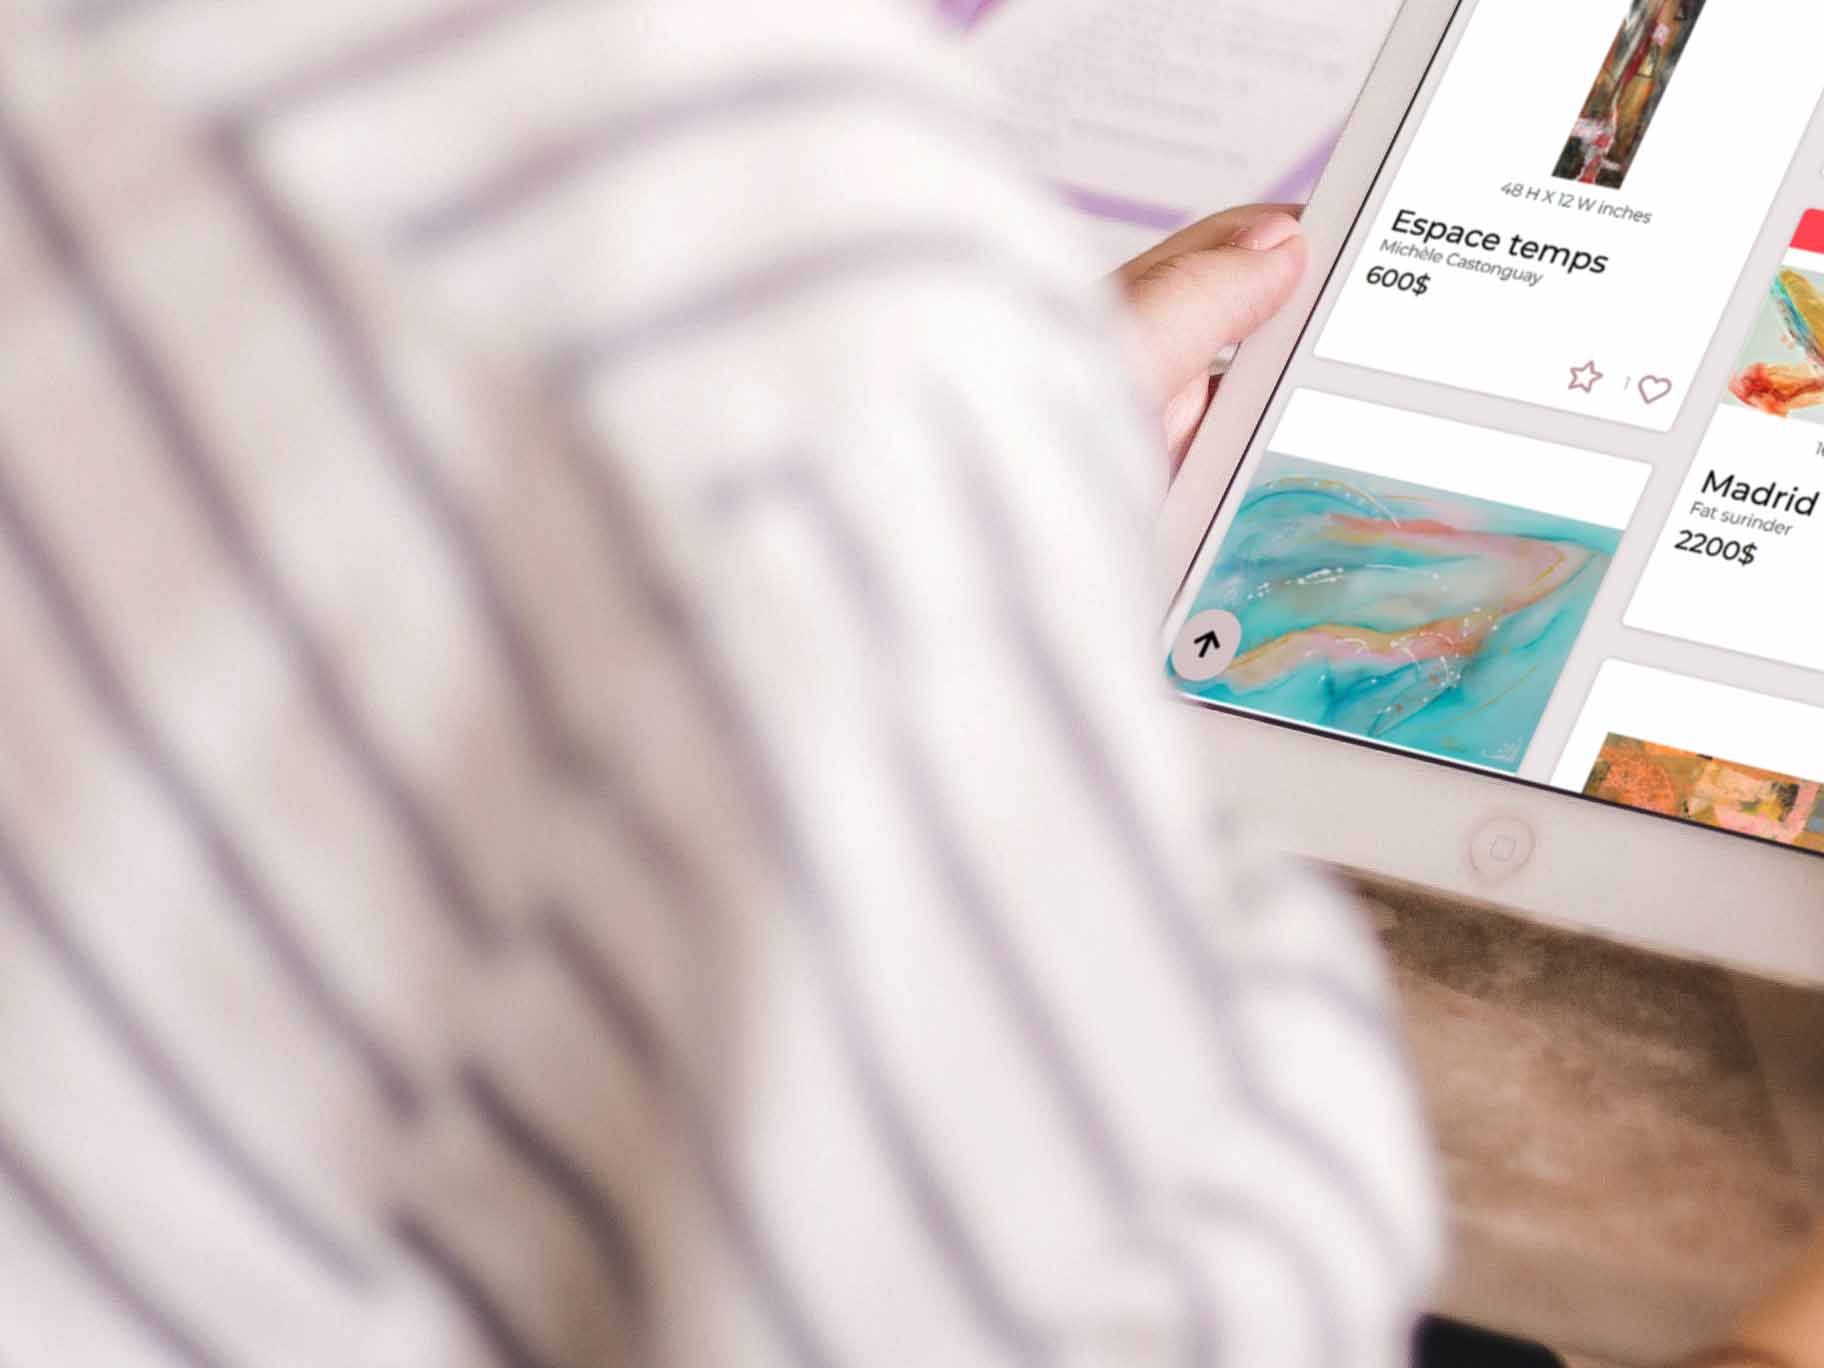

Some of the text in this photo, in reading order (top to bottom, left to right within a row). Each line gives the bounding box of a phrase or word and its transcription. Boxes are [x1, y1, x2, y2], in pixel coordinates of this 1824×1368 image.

[1500, 181, 1653, 224] 48 H X 12 W inches
[1379, 238, 1544, 287] Michèle Castonguay
[1391, 209, 1609, 274] Espace temps
[1365, 265, 1431, 296] 600$
[1700, 469, 1821, 517] Madrid
[1689, 501, 1794, 536] Fat surinder
[1674, 528, 1758, 566] 2200$
